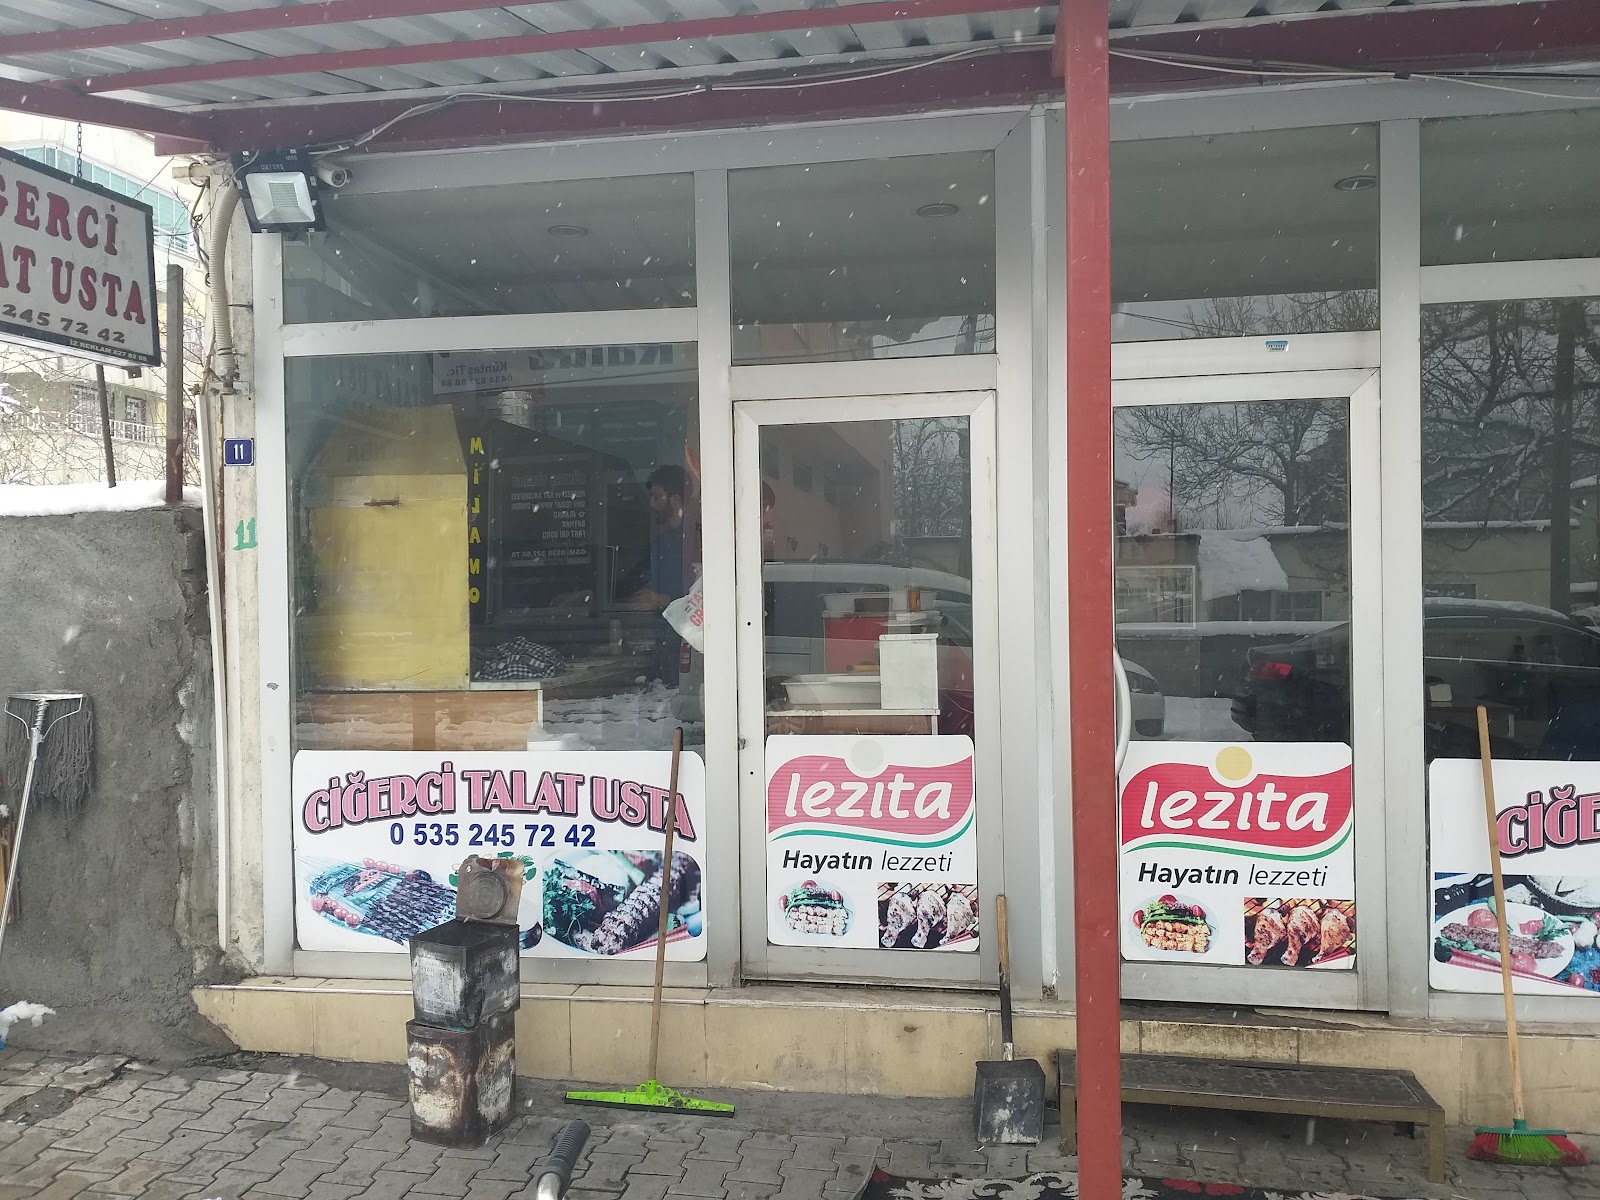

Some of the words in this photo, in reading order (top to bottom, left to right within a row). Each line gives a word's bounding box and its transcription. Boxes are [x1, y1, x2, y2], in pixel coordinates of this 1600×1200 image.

[51, 257, 146, 325] USTA
[2, 304, 50, 326] 245
[60, 317, 89, 336] 72
[97, 328, 125, 344] 42
[80, 343, 112, 354] REKLAM
[234, 444, 244, 460] 11
[233, 517, 258, 550] 11
[302, 761, 456, 836] CİĞERCİ
[462, 770, 584, 818] TALAT
[590, 775, 698, 842] USTA
[390, 822, 404, 846] 0
[413, 822, 460, 847] 535
[468, 823, 516, 848] 245
[524, 823, 556, 848] 72
[564, 824, 596, 848] 42
[783, 850, 873, 874] Hayatın
[881, 850, 953, 872] lezzeti
[1138, 862, 1239, 888] Hayatın
[1248, 864, 1328, 887] lezzeti
